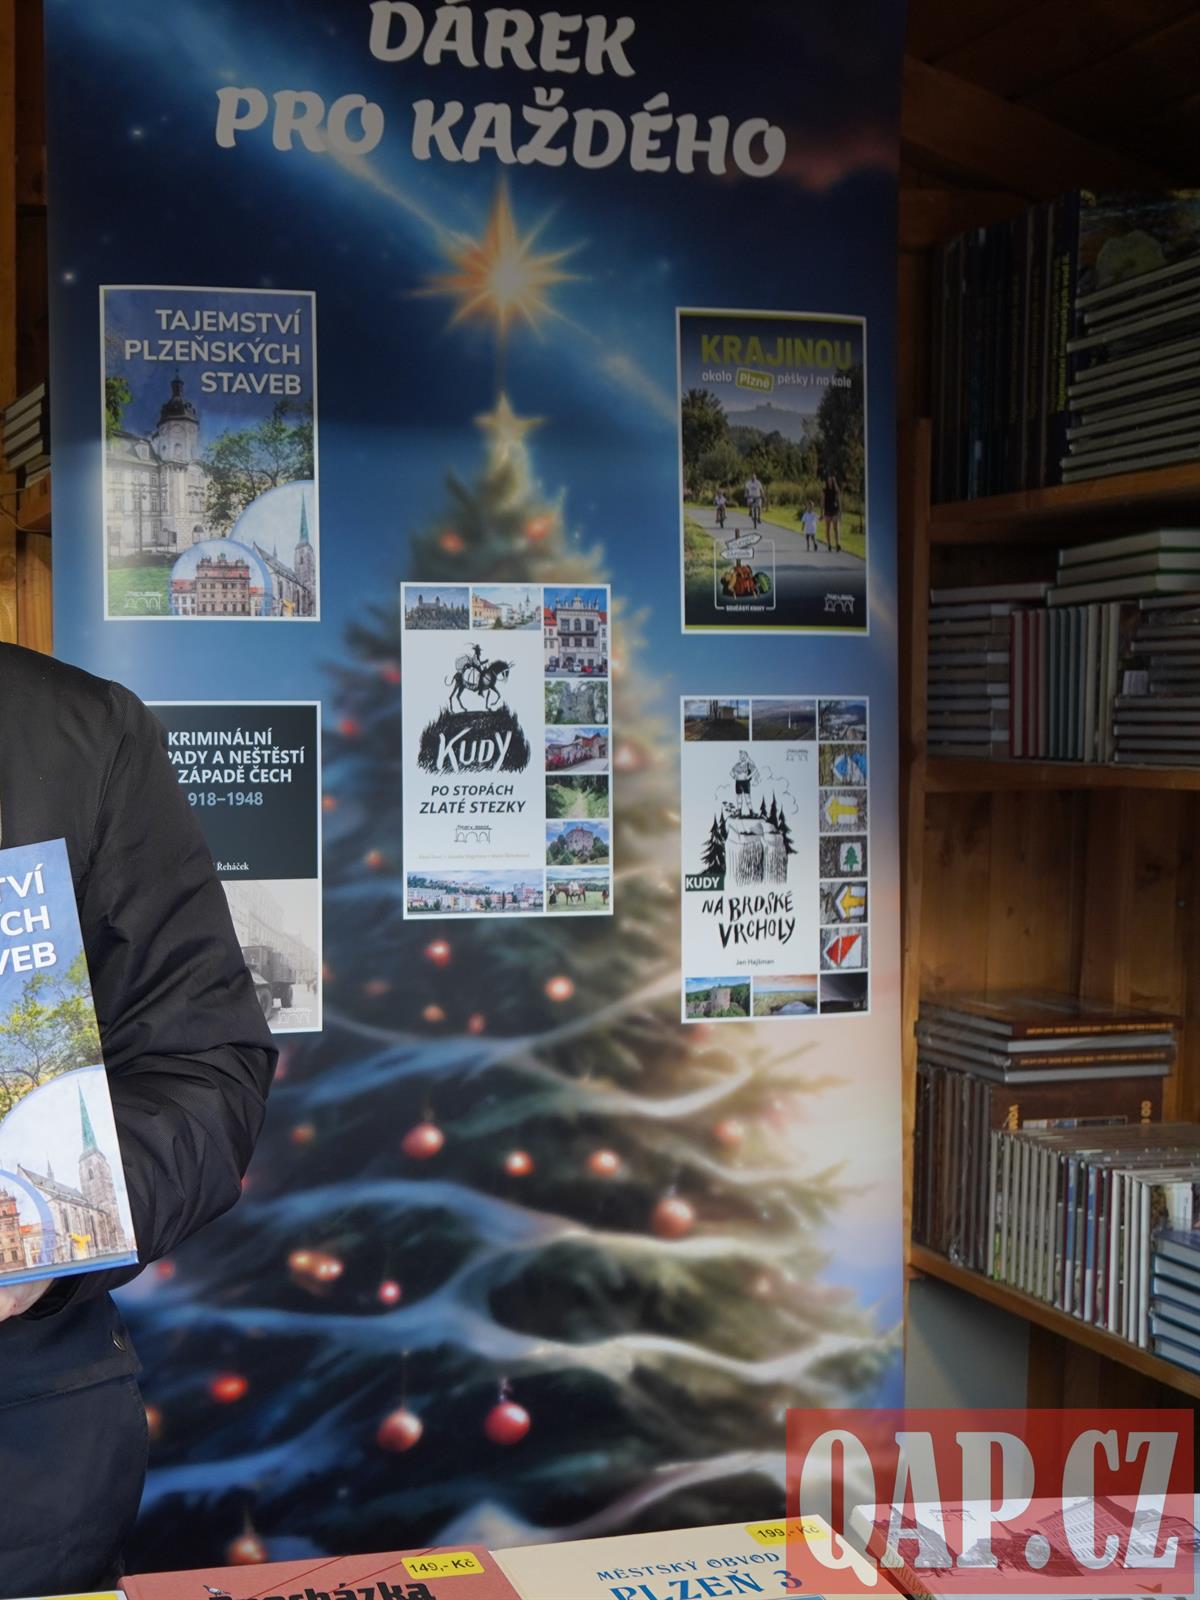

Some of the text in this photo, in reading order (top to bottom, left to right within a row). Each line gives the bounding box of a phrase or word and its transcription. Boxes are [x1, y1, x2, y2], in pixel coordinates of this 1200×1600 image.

[368, 0, 636, 77] DÁREK
[214, 86, 787, 178] PRO KAŽDÉHO
[155, 308, 302, 335] TAJEMSTVÍ
[124, 335, 301, 365] PLZEŇSKÝCH
[701, 334, 852, 370] KRAJINOU
[201, 372, 302, 396] STAVEB
[702, 370, 732, 383] okolo
[816, 376, 830, 387] na
[831, 376, 852, 389] kole
[168, 728, 273, 746] KRIMINÁLNÍ
[212, 751, 225, 764] A
[229, 746, 305, 764] NEŠTĚSTÍ
[178, 765, 292, 783] ZÁPADĚ ČECH
[188, 791, 264, 806] 918–1948
[431, 782, 514, 797] PO STOPÁCH
[419, 797, 527, 814] ZLATÉ STEZKY
[685, 876, 720, 889] KUDY
[702, 891, 793, 922] NA BRDSKÉ
[718, 917, 796, 949] VRCHOLY
[409, 1558, 475, 1573] 149,- Kč
[596, 1552, 781, 1581] MĚSTSKÝ OBVOD
[609, 1569, 803, 1600] PLZEŇ 3
